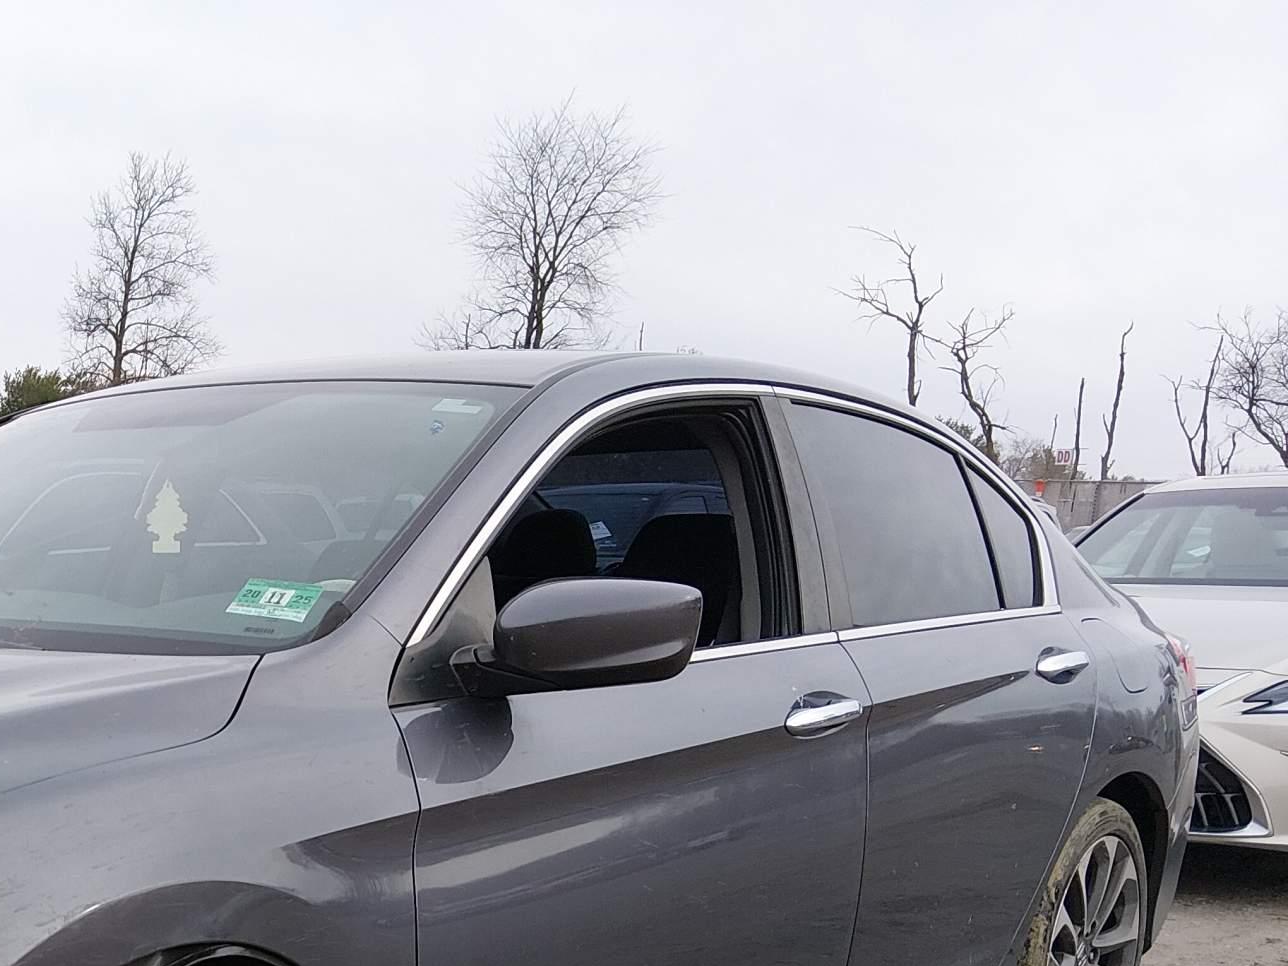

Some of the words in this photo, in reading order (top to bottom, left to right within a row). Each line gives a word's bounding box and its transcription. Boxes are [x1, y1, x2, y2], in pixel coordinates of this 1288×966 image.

[1057, 450, 1071, 463] DD
[243, 589, 262, 599] 20
[264, 591, 287, 605] 11
[292, 595, 314, 605] 25
